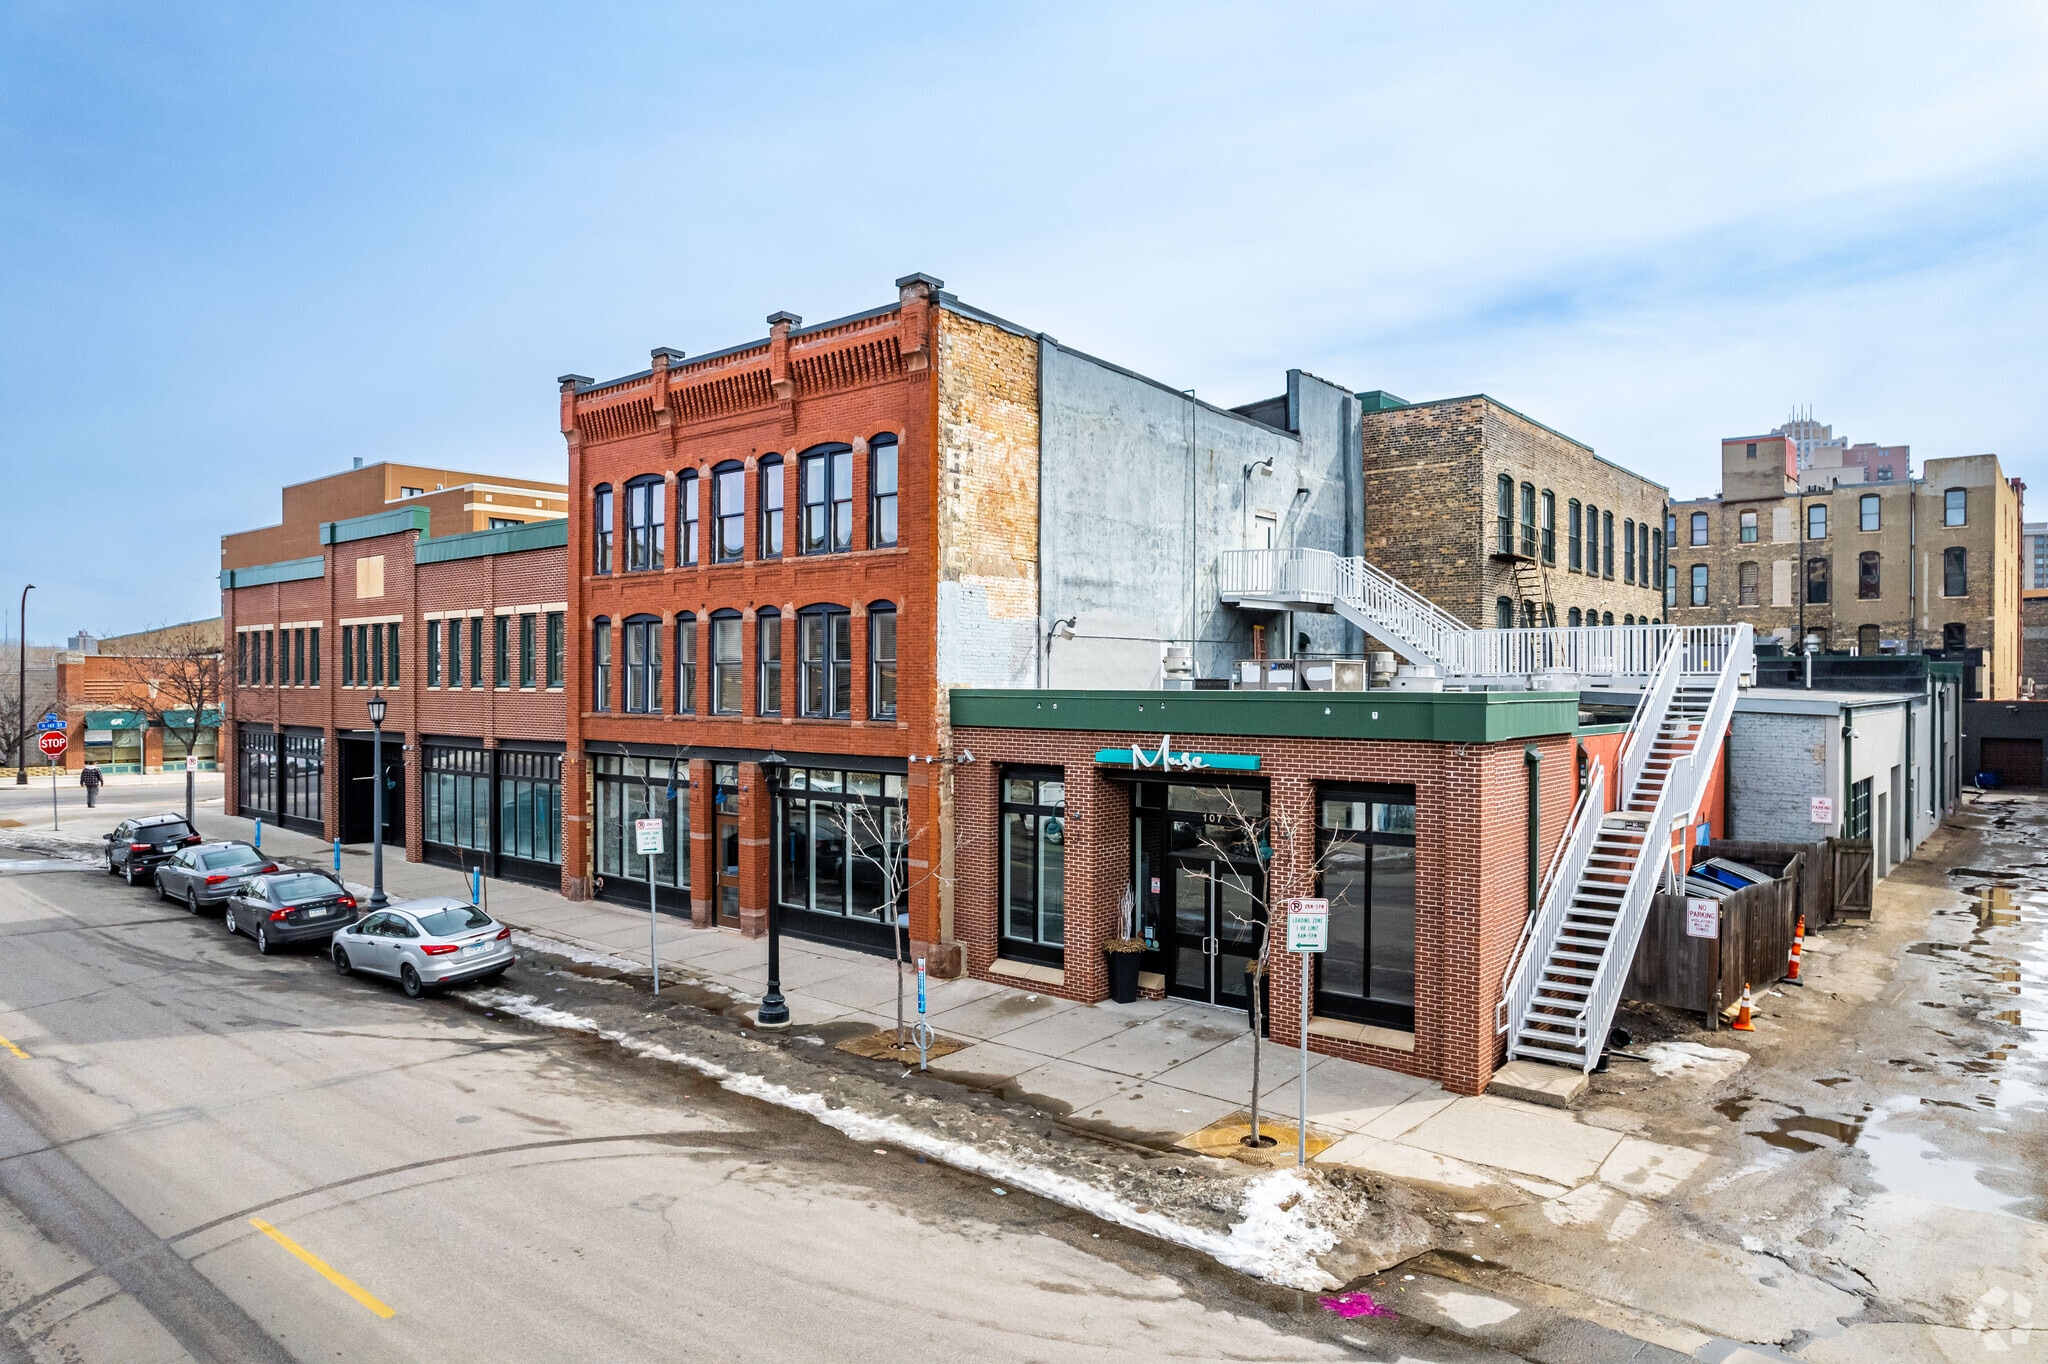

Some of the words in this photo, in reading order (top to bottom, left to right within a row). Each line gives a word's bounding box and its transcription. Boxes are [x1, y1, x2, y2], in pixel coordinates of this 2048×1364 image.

[1277, 662, 1295, 670] YORK
[41, 738, 66, 749] STOP
[1131, 734, 1210, 772] Muse
[1203, 813, 1223, 823] 107
[1690, 910, 1715, 920] PARKING
